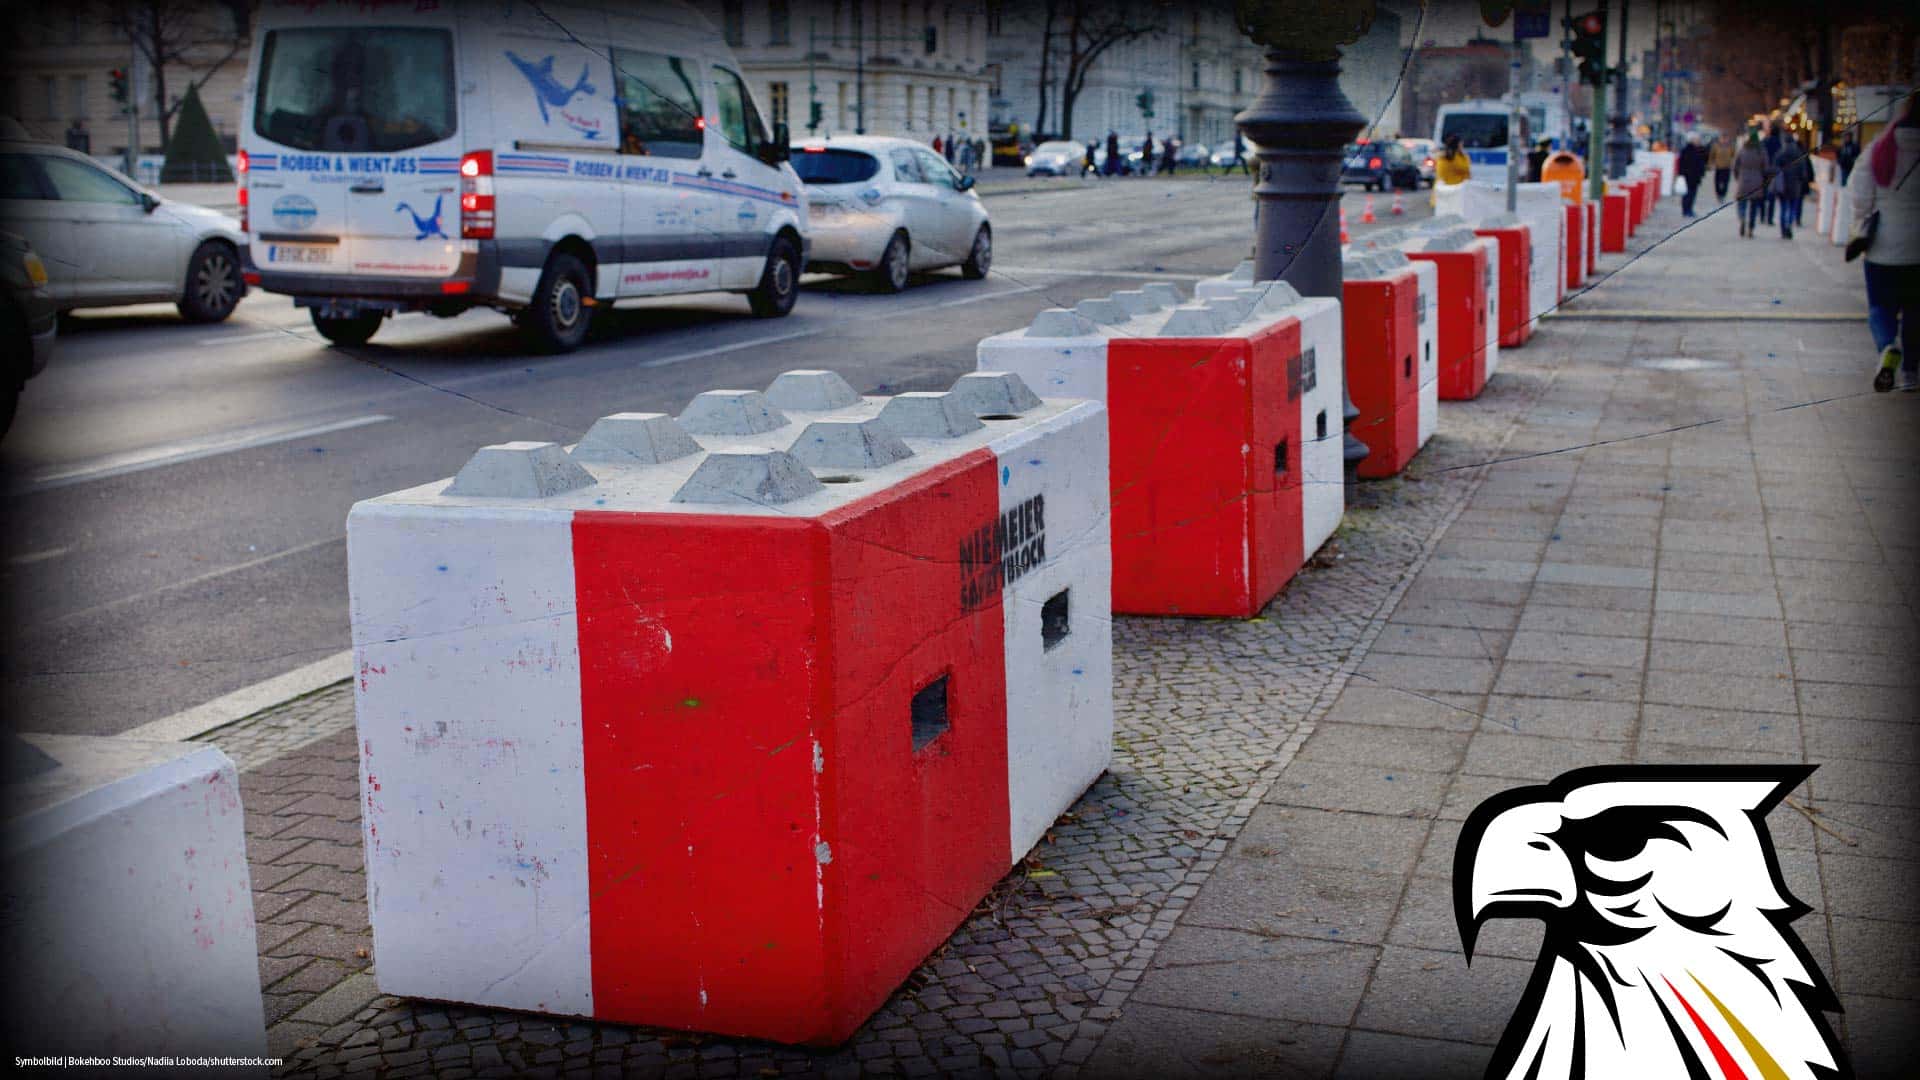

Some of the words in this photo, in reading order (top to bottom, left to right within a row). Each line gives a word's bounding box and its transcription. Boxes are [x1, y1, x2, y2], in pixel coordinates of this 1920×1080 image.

[281, 155, 330, 172] ROBBEN
[335, 157, 343, 172] &
[348, 157, 417, 174] WIENTJES
[574, 160, 614, 177] ROBBEN
[960, 493, 1045, 577] NIEMEIER
